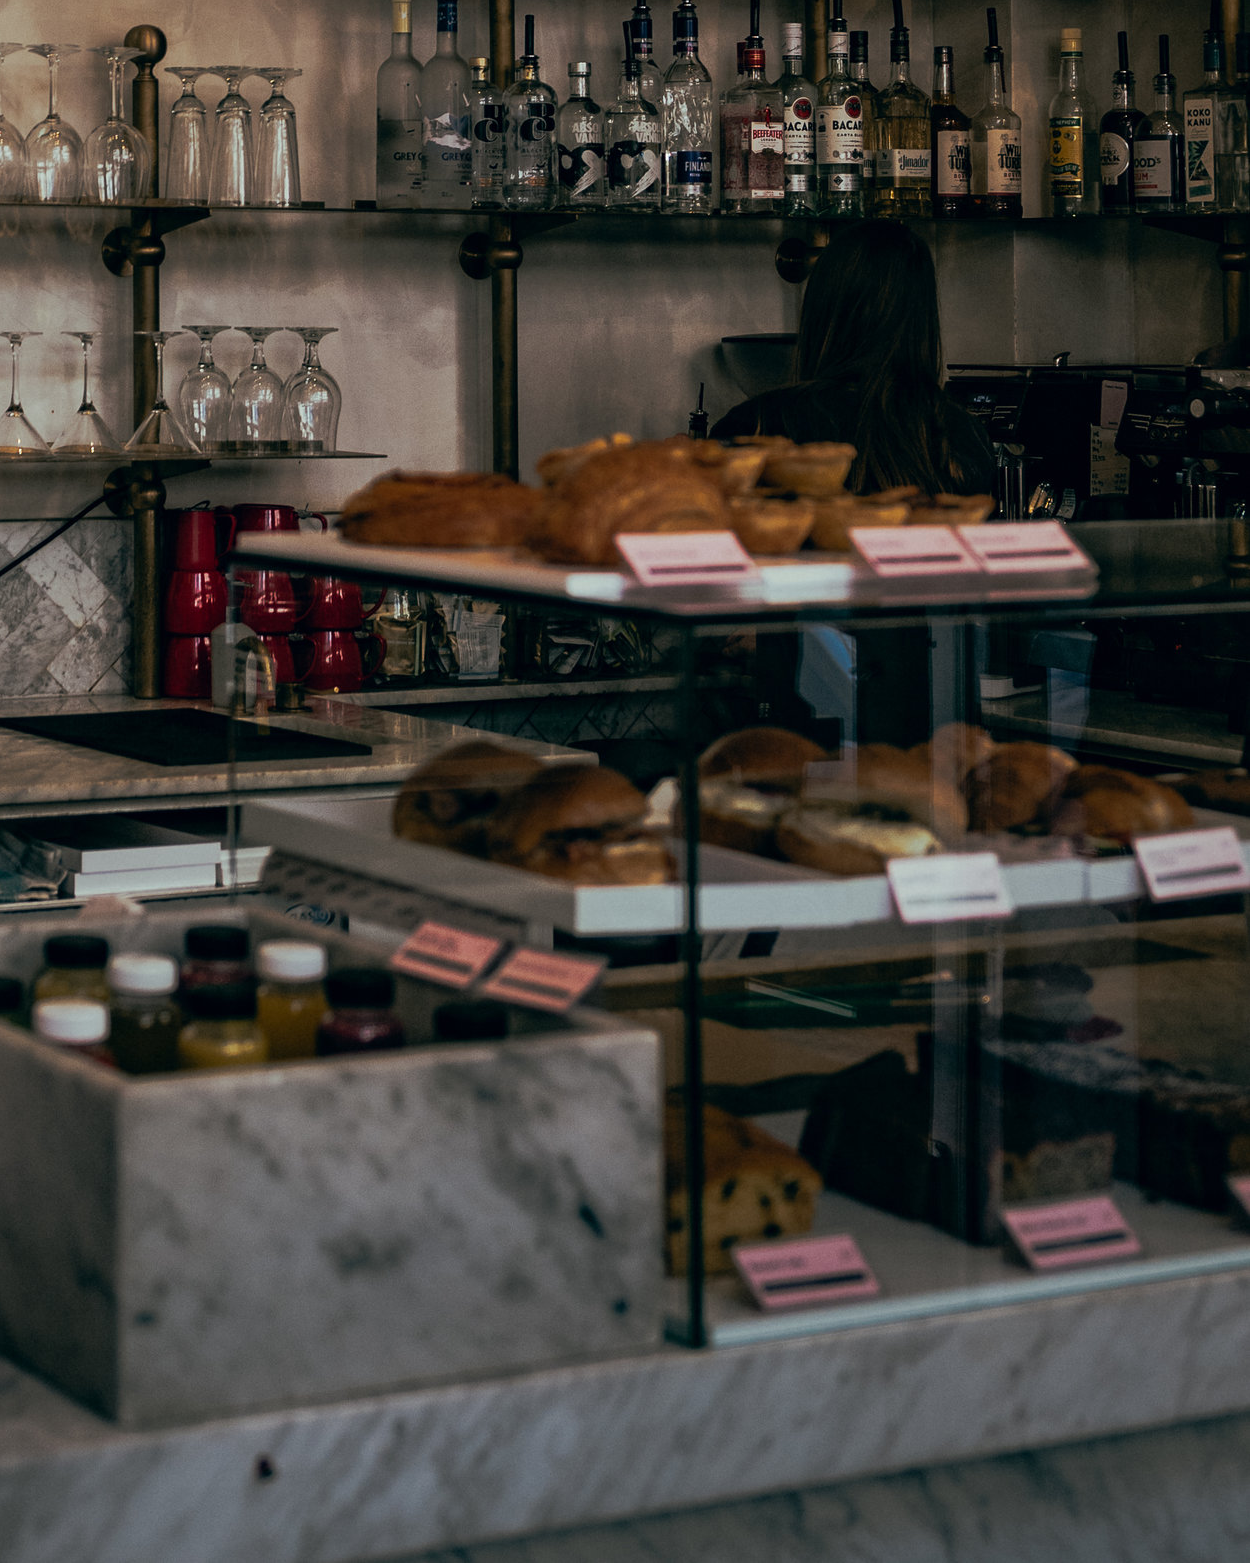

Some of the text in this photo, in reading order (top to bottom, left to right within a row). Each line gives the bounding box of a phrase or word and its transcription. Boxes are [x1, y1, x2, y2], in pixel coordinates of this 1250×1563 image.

[1186, 108, 1212, 118] KOKO
[1186, 118, 1212, 127] KANU
[752, 129, 784, 141] BEEFEATER
[393, 151, 417, 161] GREY
[441, 152, 465, 161] GREY
[900, 154, 929, 170] Jimador
